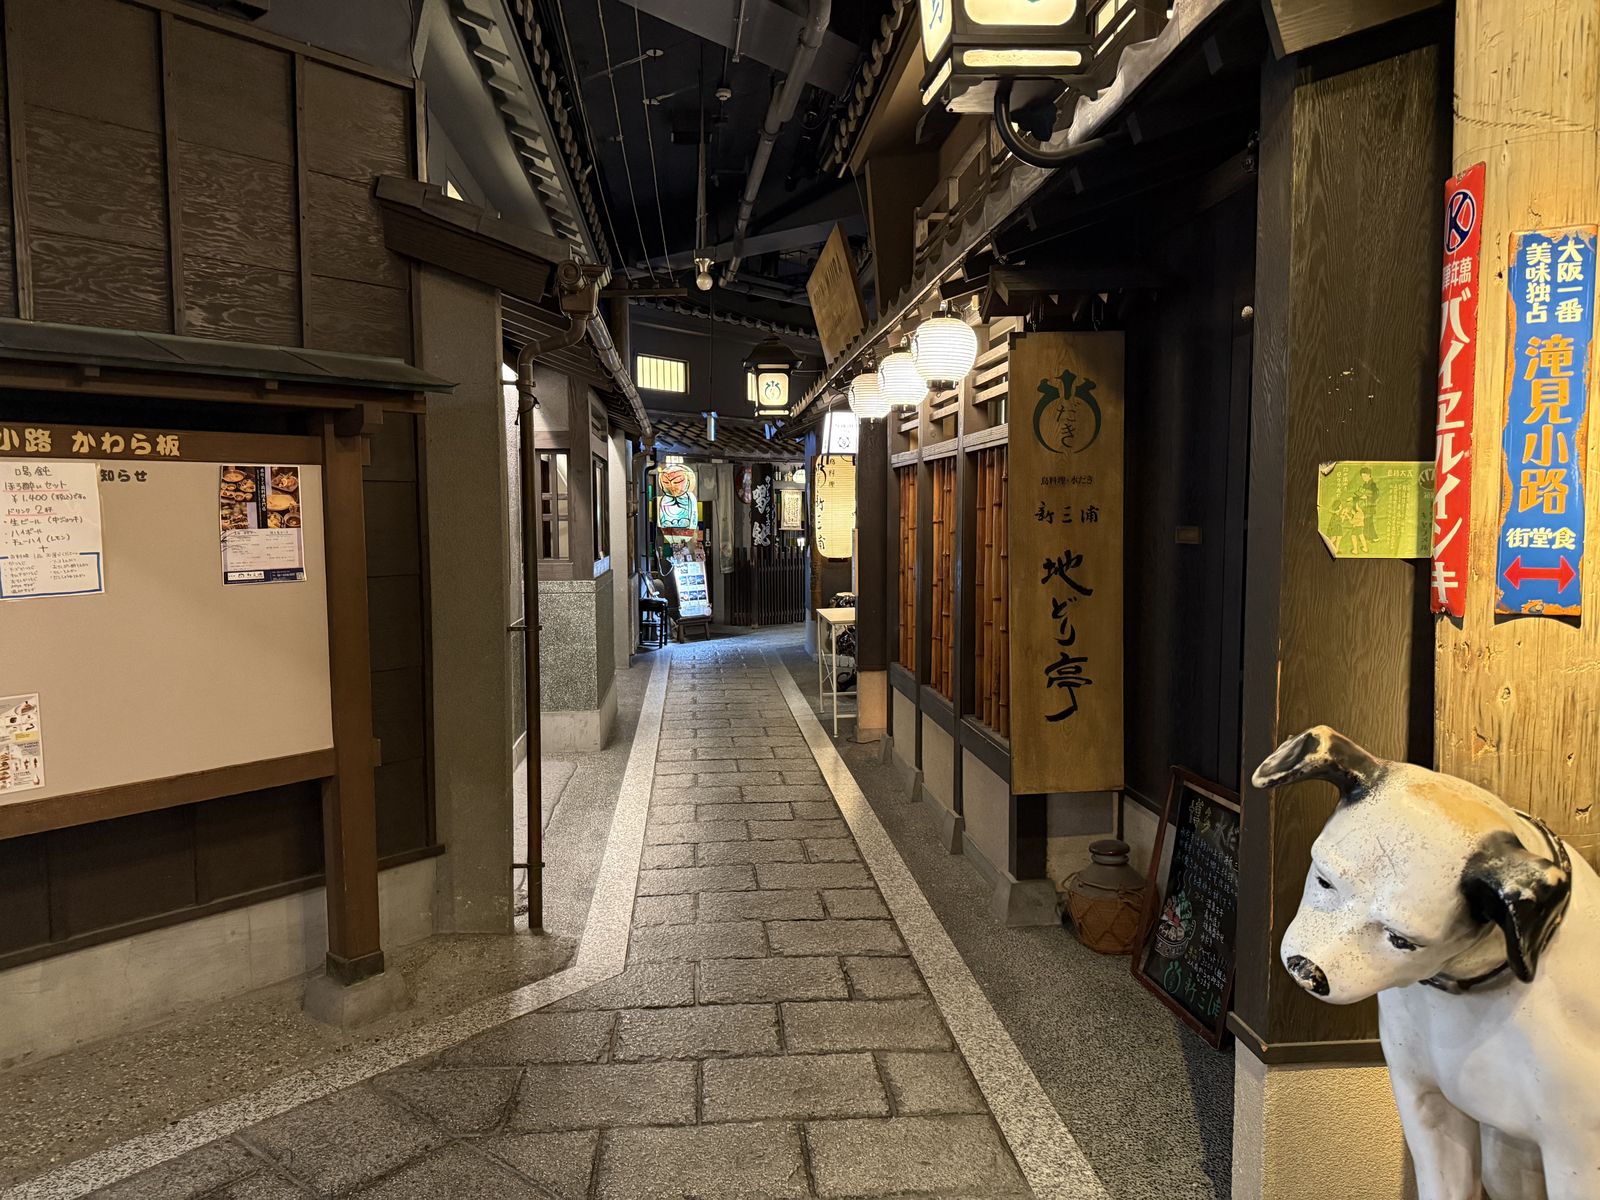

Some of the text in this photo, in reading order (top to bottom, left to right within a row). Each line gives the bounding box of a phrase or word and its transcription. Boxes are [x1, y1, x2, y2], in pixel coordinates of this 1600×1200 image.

[1526, 242, 1552, 324] 美味独占
[1555, 239, 1585, 323] 大阪一番
[1518, 333, 1574, 515] 滝見小路
[1034, 501, 1100, 524] 新三浦
[1040, 549, 1094, 722] 地どり亭
